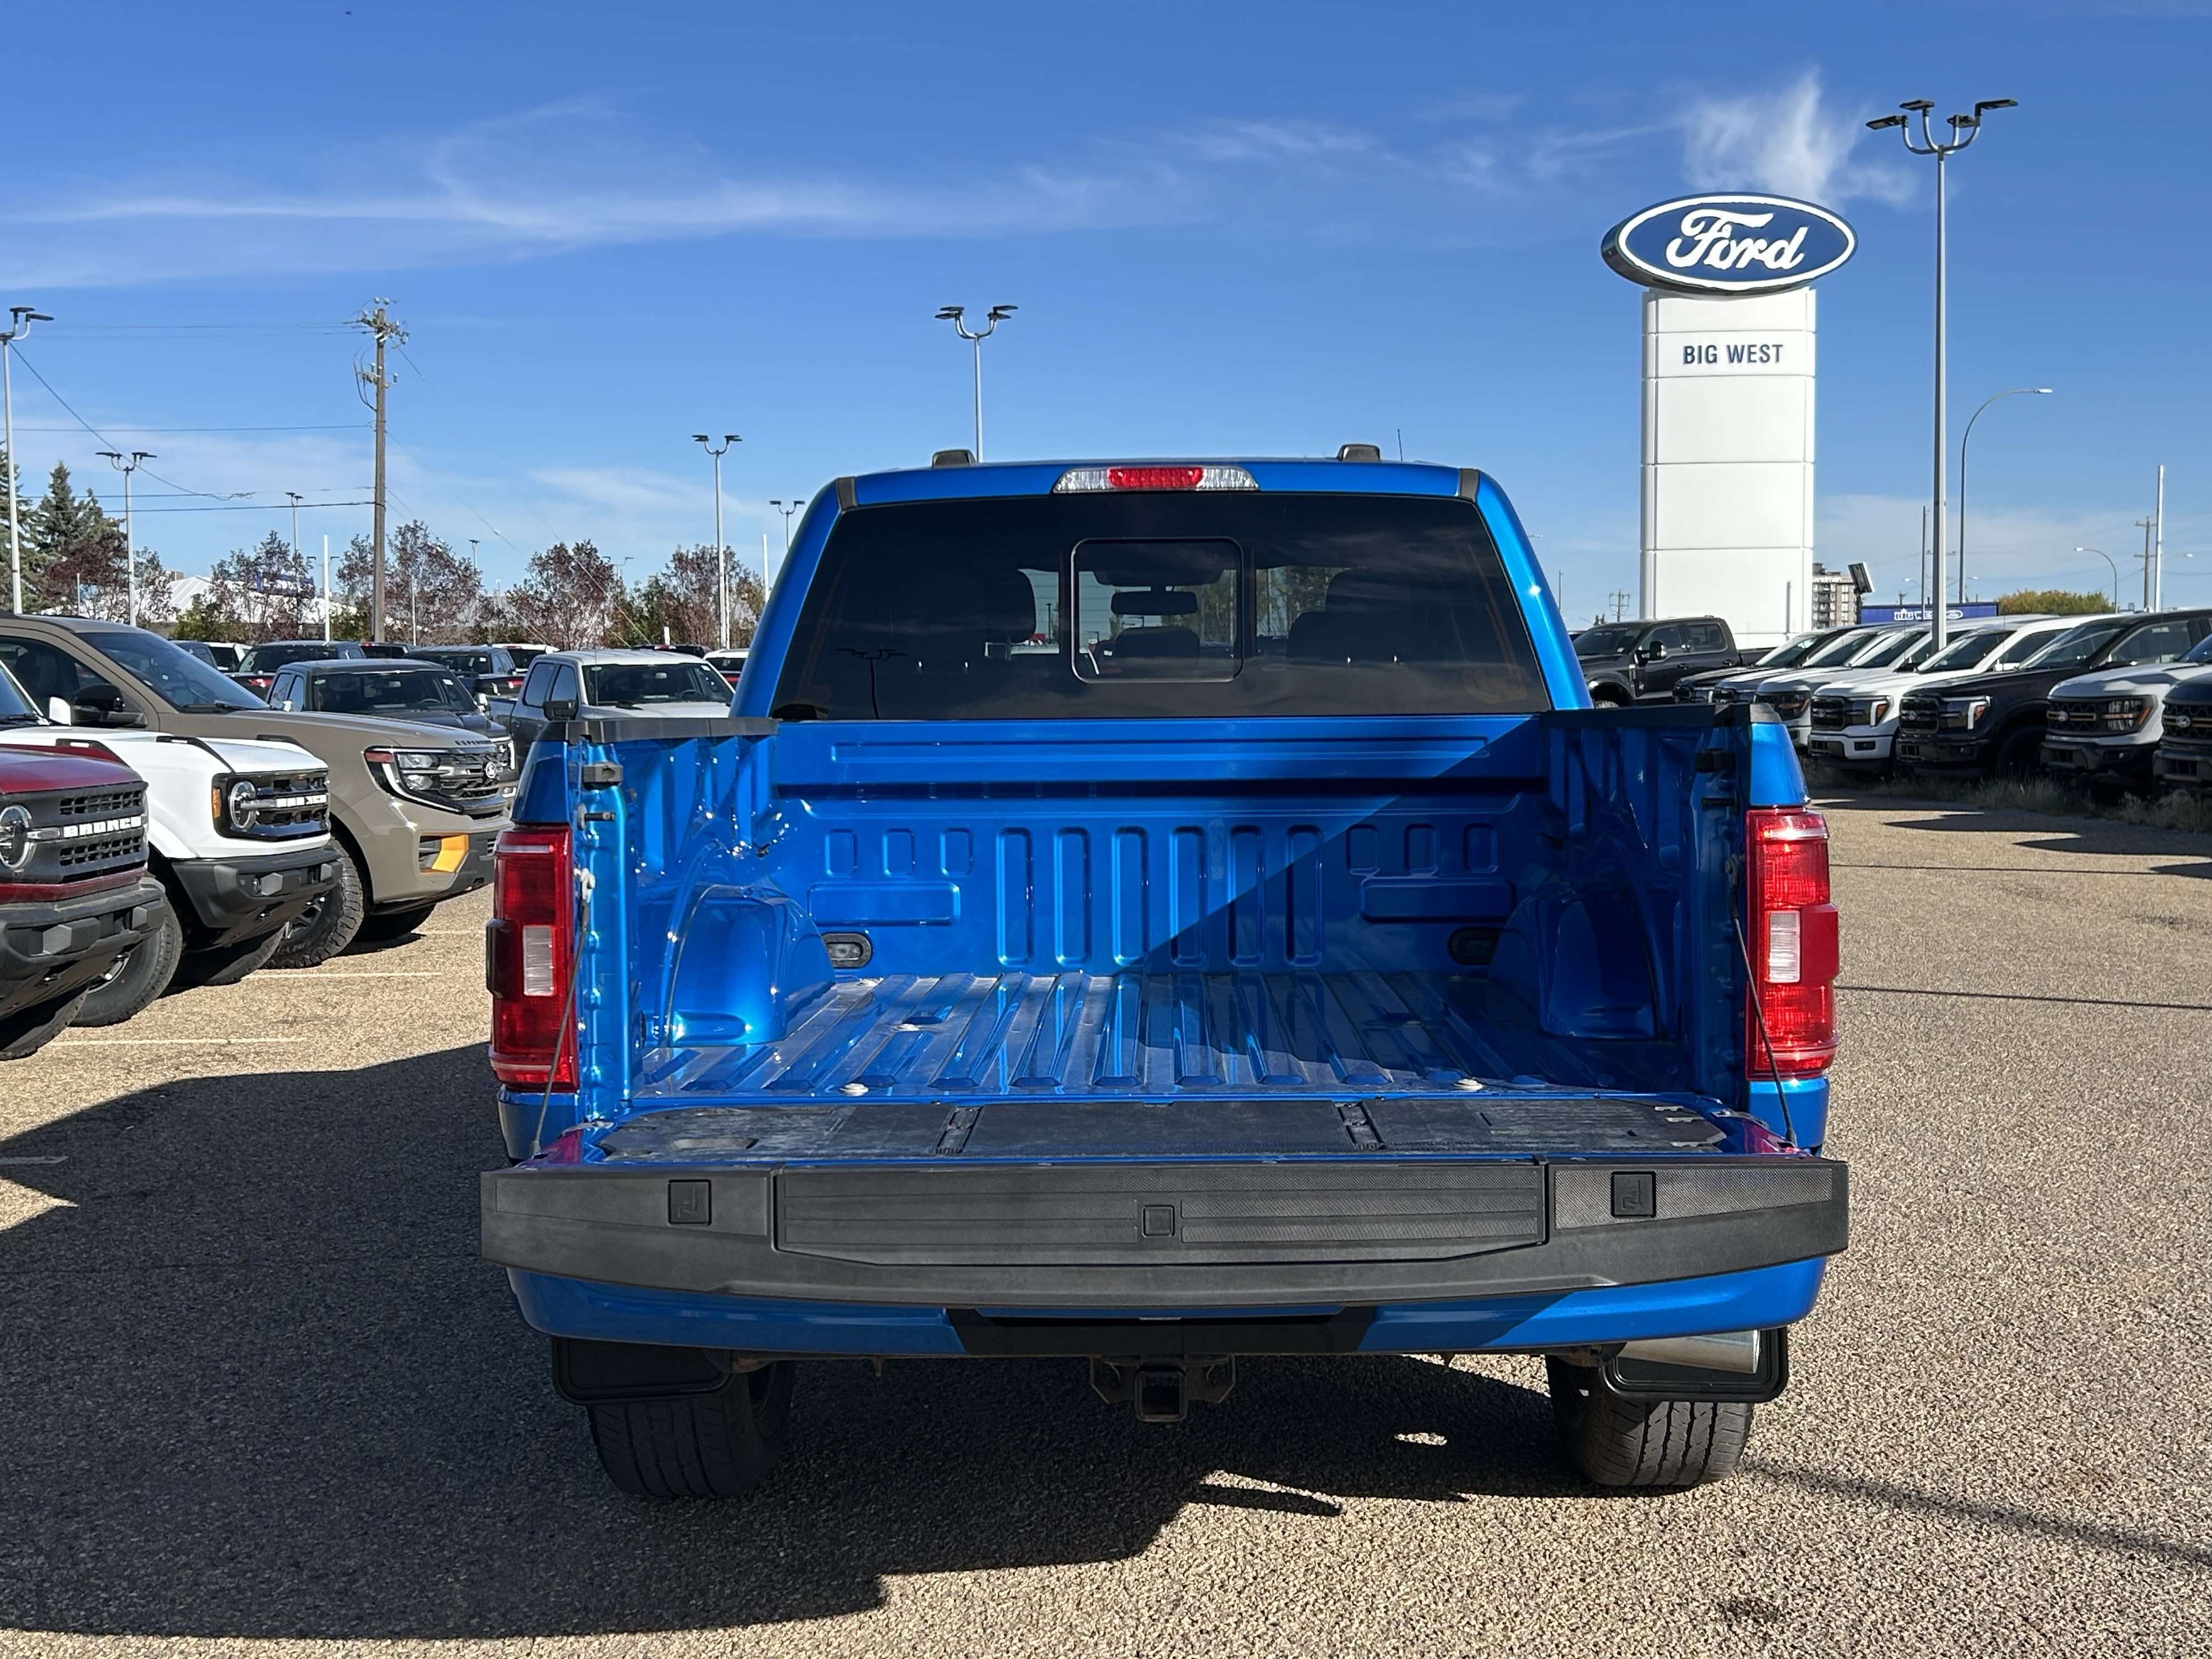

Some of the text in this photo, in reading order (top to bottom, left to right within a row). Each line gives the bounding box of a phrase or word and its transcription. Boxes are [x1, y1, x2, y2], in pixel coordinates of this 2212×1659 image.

[1666, 209, 1808, 270] Ford
[1683, 344, 1783, 364] BIG WEST
[64, 816, 142, 838] BRONCO
